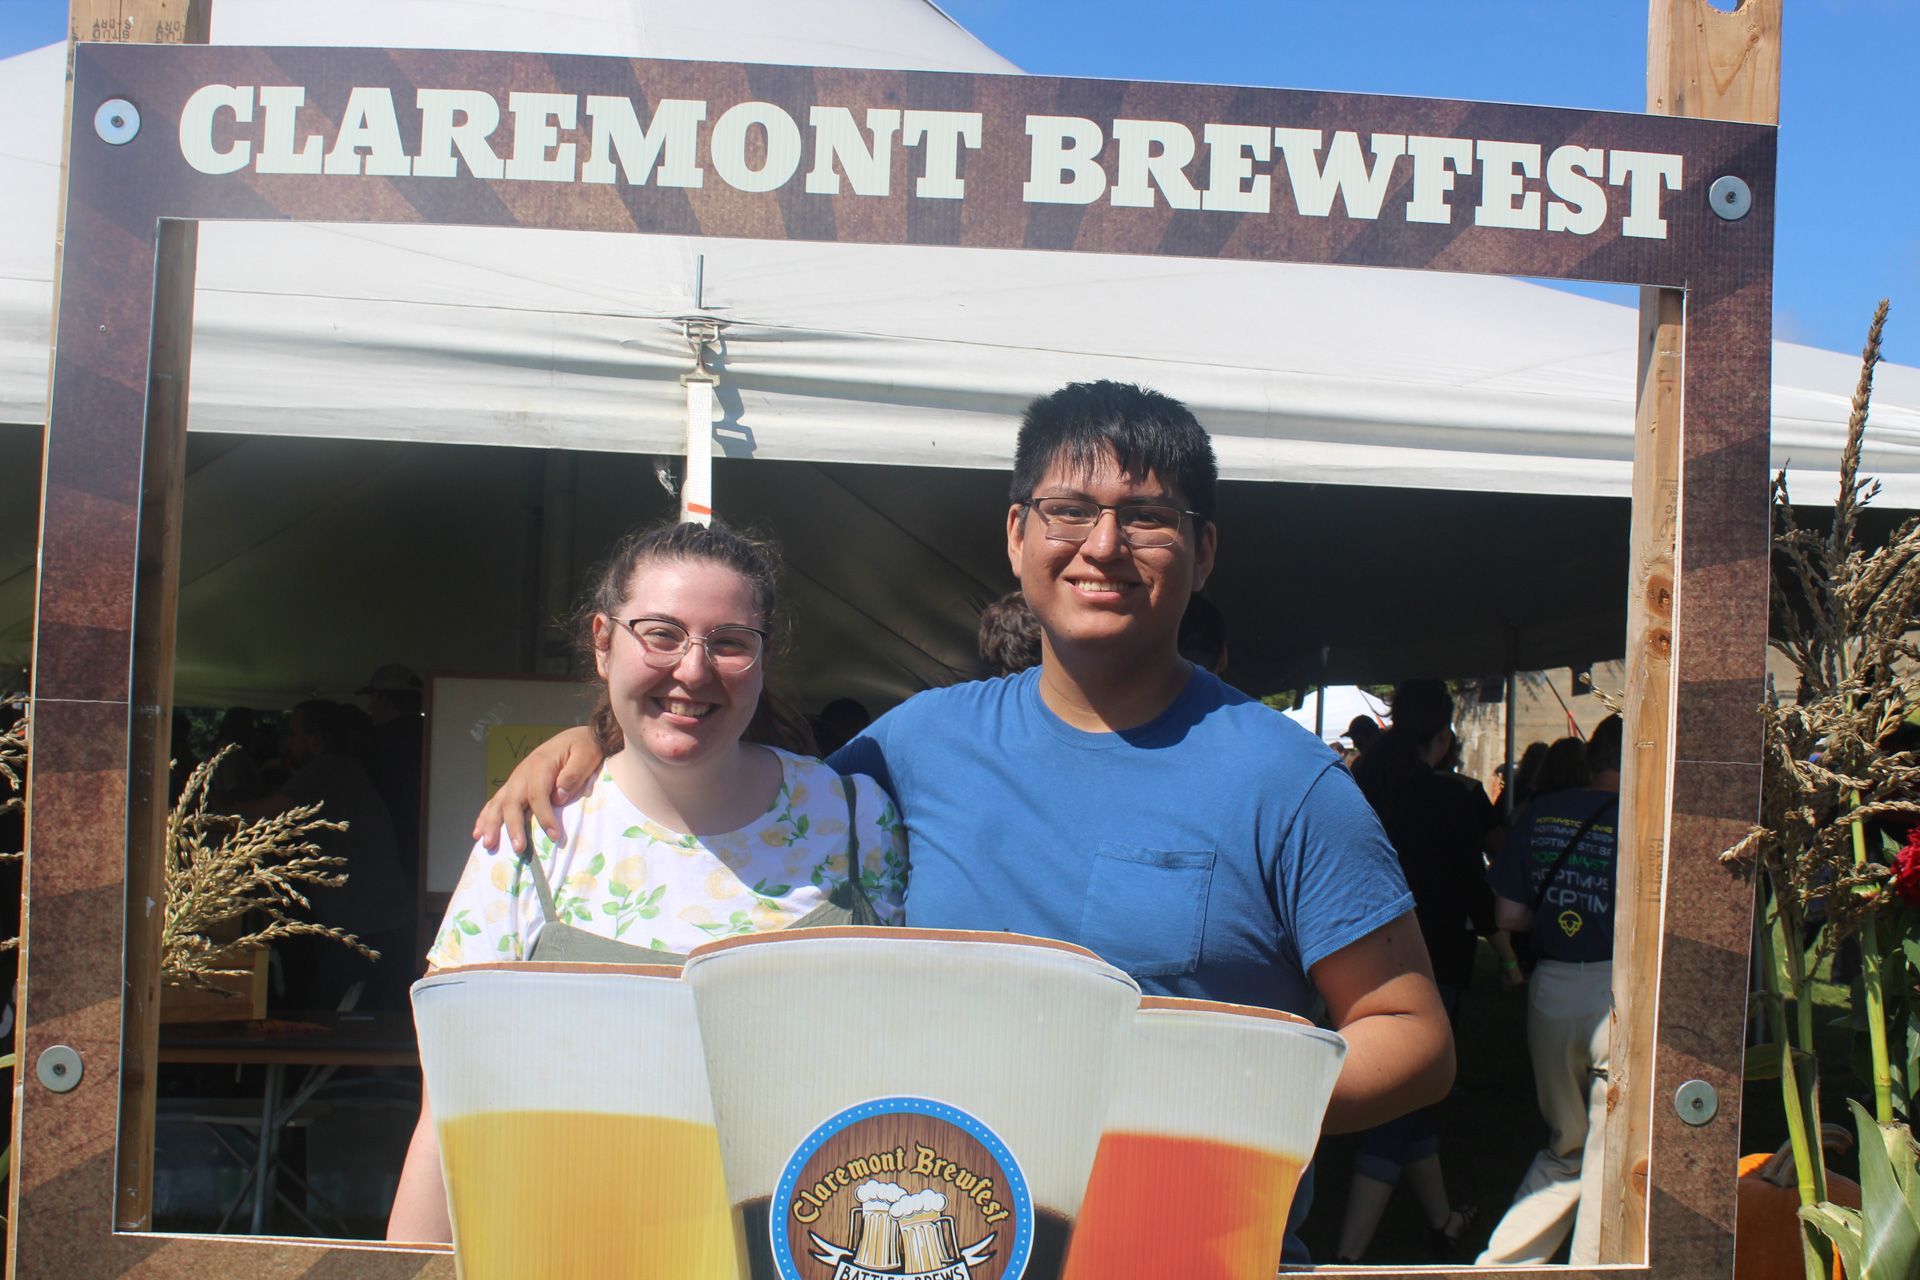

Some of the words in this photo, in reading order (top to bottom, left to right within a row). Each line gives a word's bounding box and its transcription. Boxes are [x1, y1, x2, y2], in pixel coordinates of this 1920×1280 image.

[179, 84, 983, 200] CLAREMONT
[1023, 115, 1683, 239] BREWFEST
[792, 1147, 905, 1224] Claremont
[910, 1140, 1010, 1225] Brewfest
